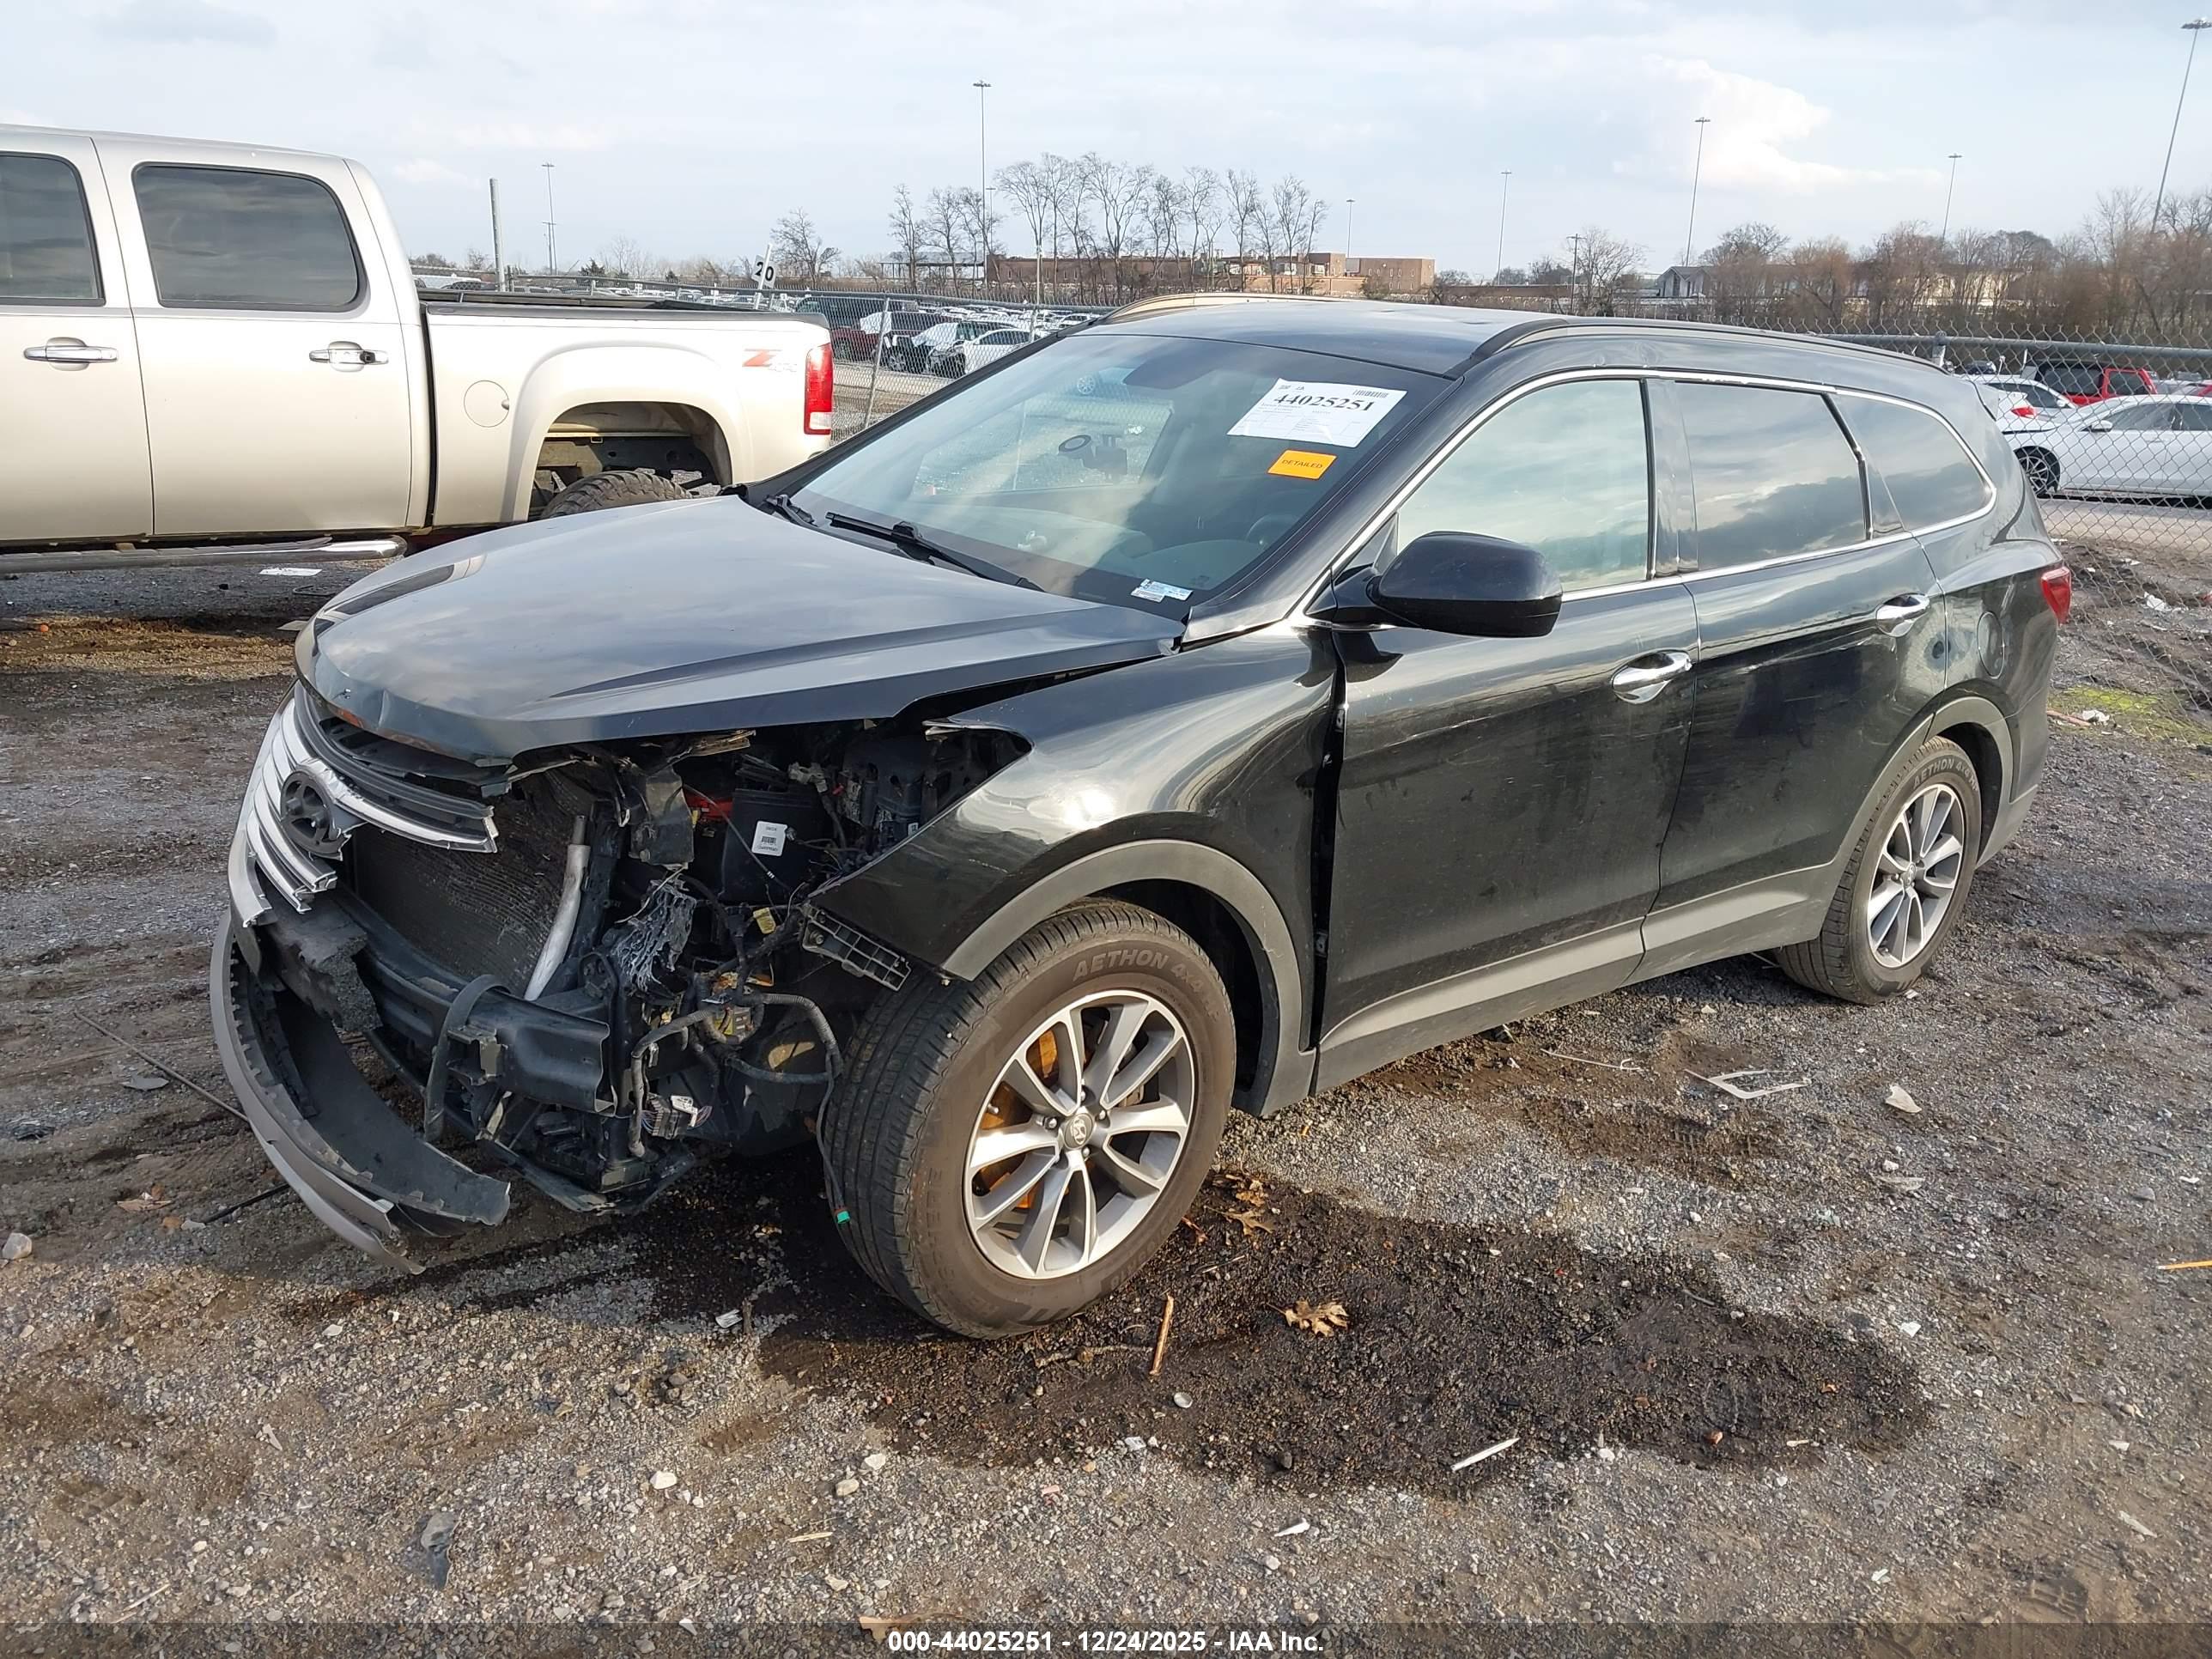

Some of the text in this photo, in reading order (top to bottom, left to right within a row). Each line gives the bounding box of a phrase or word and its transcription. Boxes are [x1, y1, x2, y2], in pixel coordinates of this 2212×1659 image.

[755, 261, 774, 282] 20
[1273, 393, 1375, 411] 44025251
[1281, 459, 1323, 469] DETAILED
[1913, 758, 1954, 790] AETHON
[1073, 948, 1170, 982] AETHON
